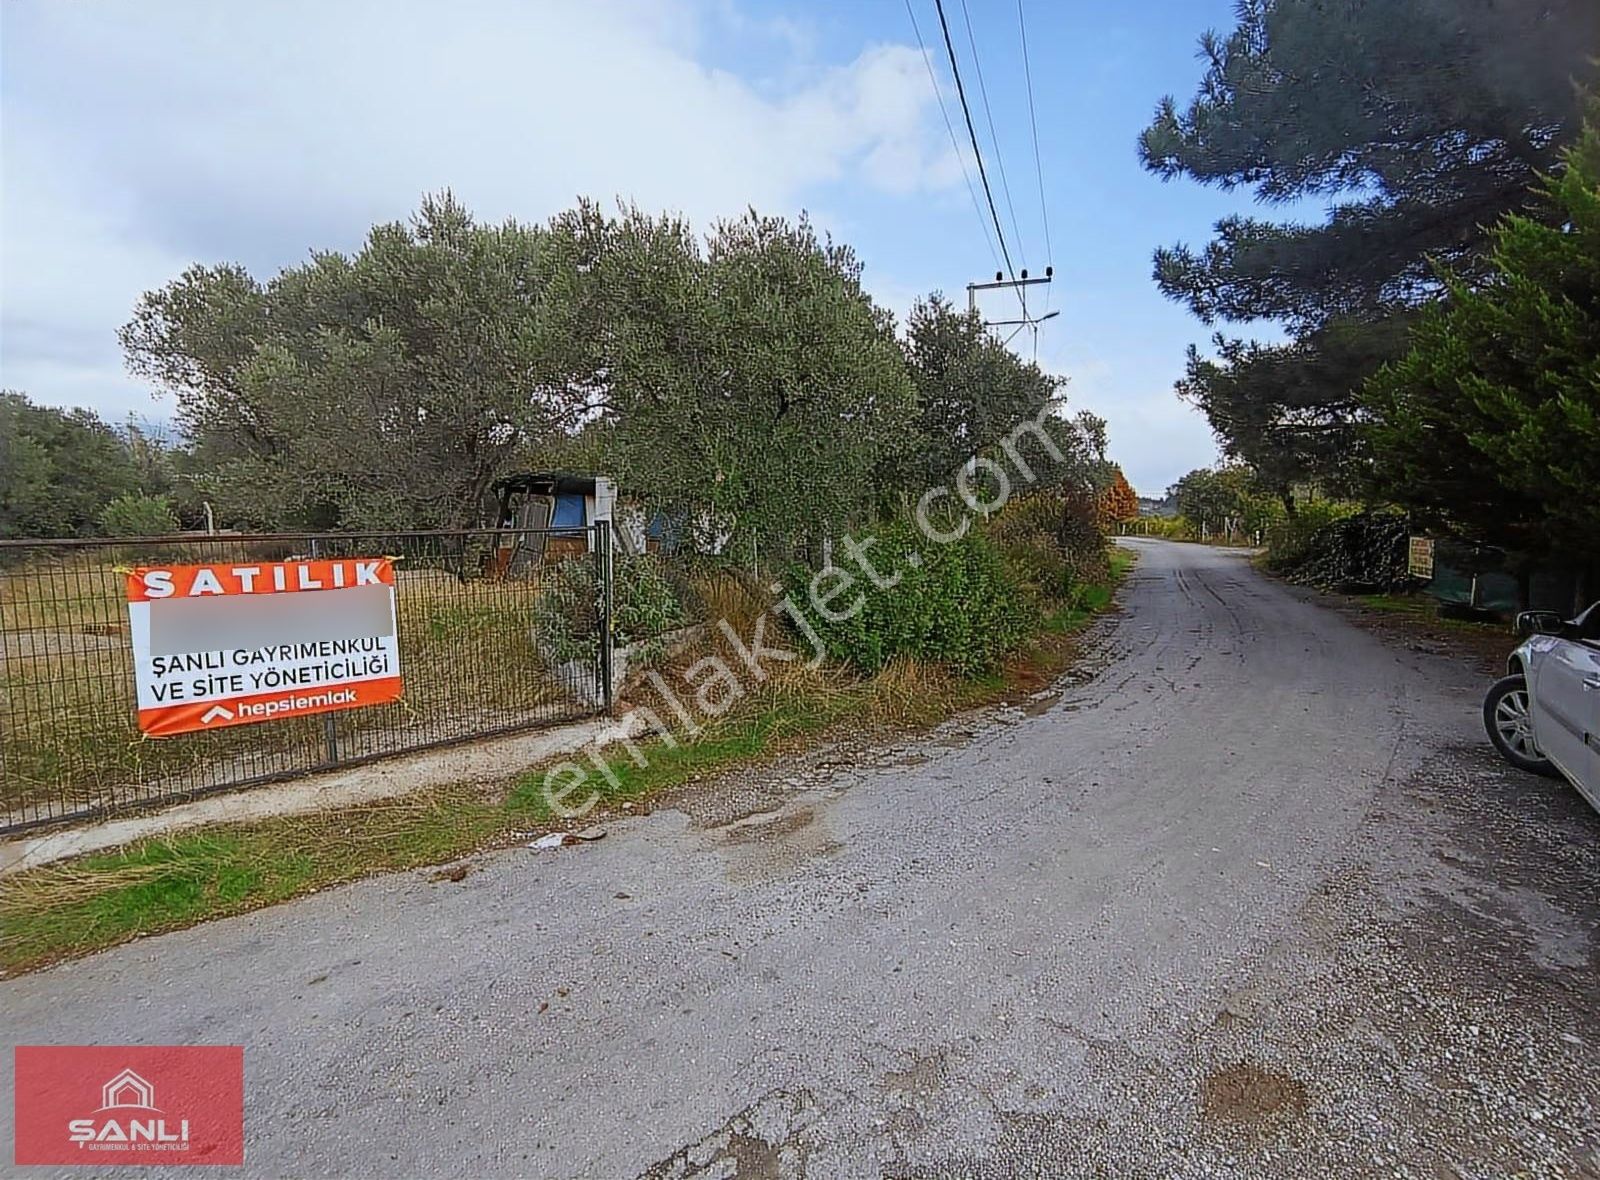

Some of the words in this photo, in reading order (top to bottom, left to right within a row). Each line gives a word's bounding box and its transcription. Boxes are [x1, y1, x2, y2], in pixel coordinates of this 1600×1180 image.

[144, 563, 383, 597] SATILIK
[151, 682, 184, 702] VE
[193, 674, 243, 697] SİTE
[250, 654, 389, 689] YÖNETİCİLİĞİ
[152, 651, 225, 678] ŞANLI
[238, 688, 357, 717] hepsiemlak
